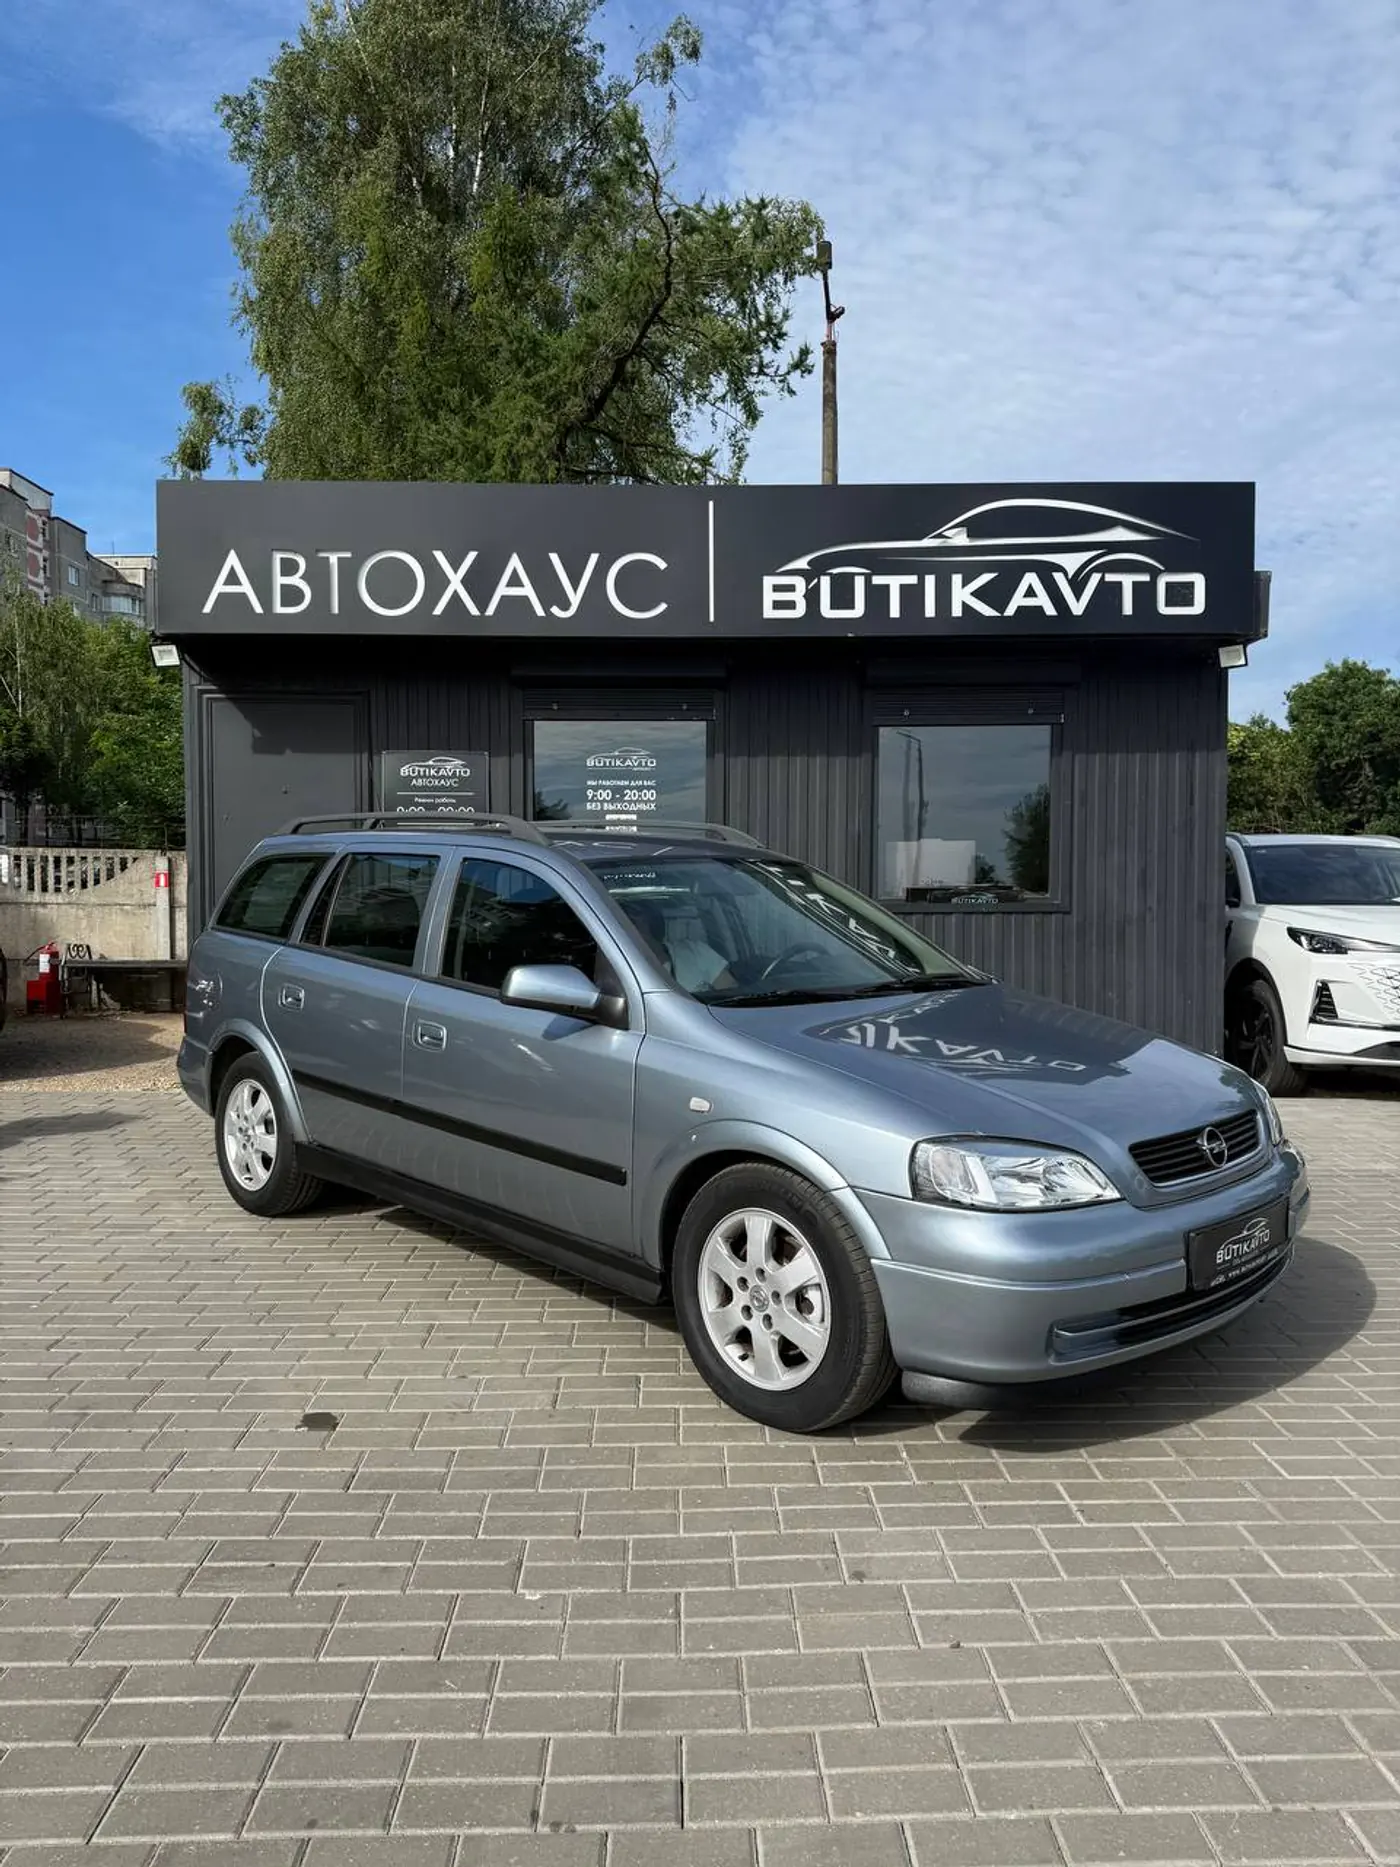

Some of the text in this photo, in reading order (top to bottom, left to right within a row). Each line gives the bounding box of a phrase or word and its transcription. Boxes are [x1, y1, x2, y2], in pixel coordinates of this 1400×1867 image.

[202, 548, 669, 619] АВТОХАУС
[762, 572, 1206, 619] BUTIKAVTO
[586, 758, 656, 767] BUTIKAVTO
[400, 767, 470, 777] BUTIKAVTO
[411, 778, 459, 787] АВТОХАУС
[586, 789, 612, 801] 9:00
[623, 789, 656, 801] 20:00
[586, 802, 656, 811] БЕЗ ВЫХОДНЫХ
[1216, 1229, 1270, 1264] BUTIKAVTO
